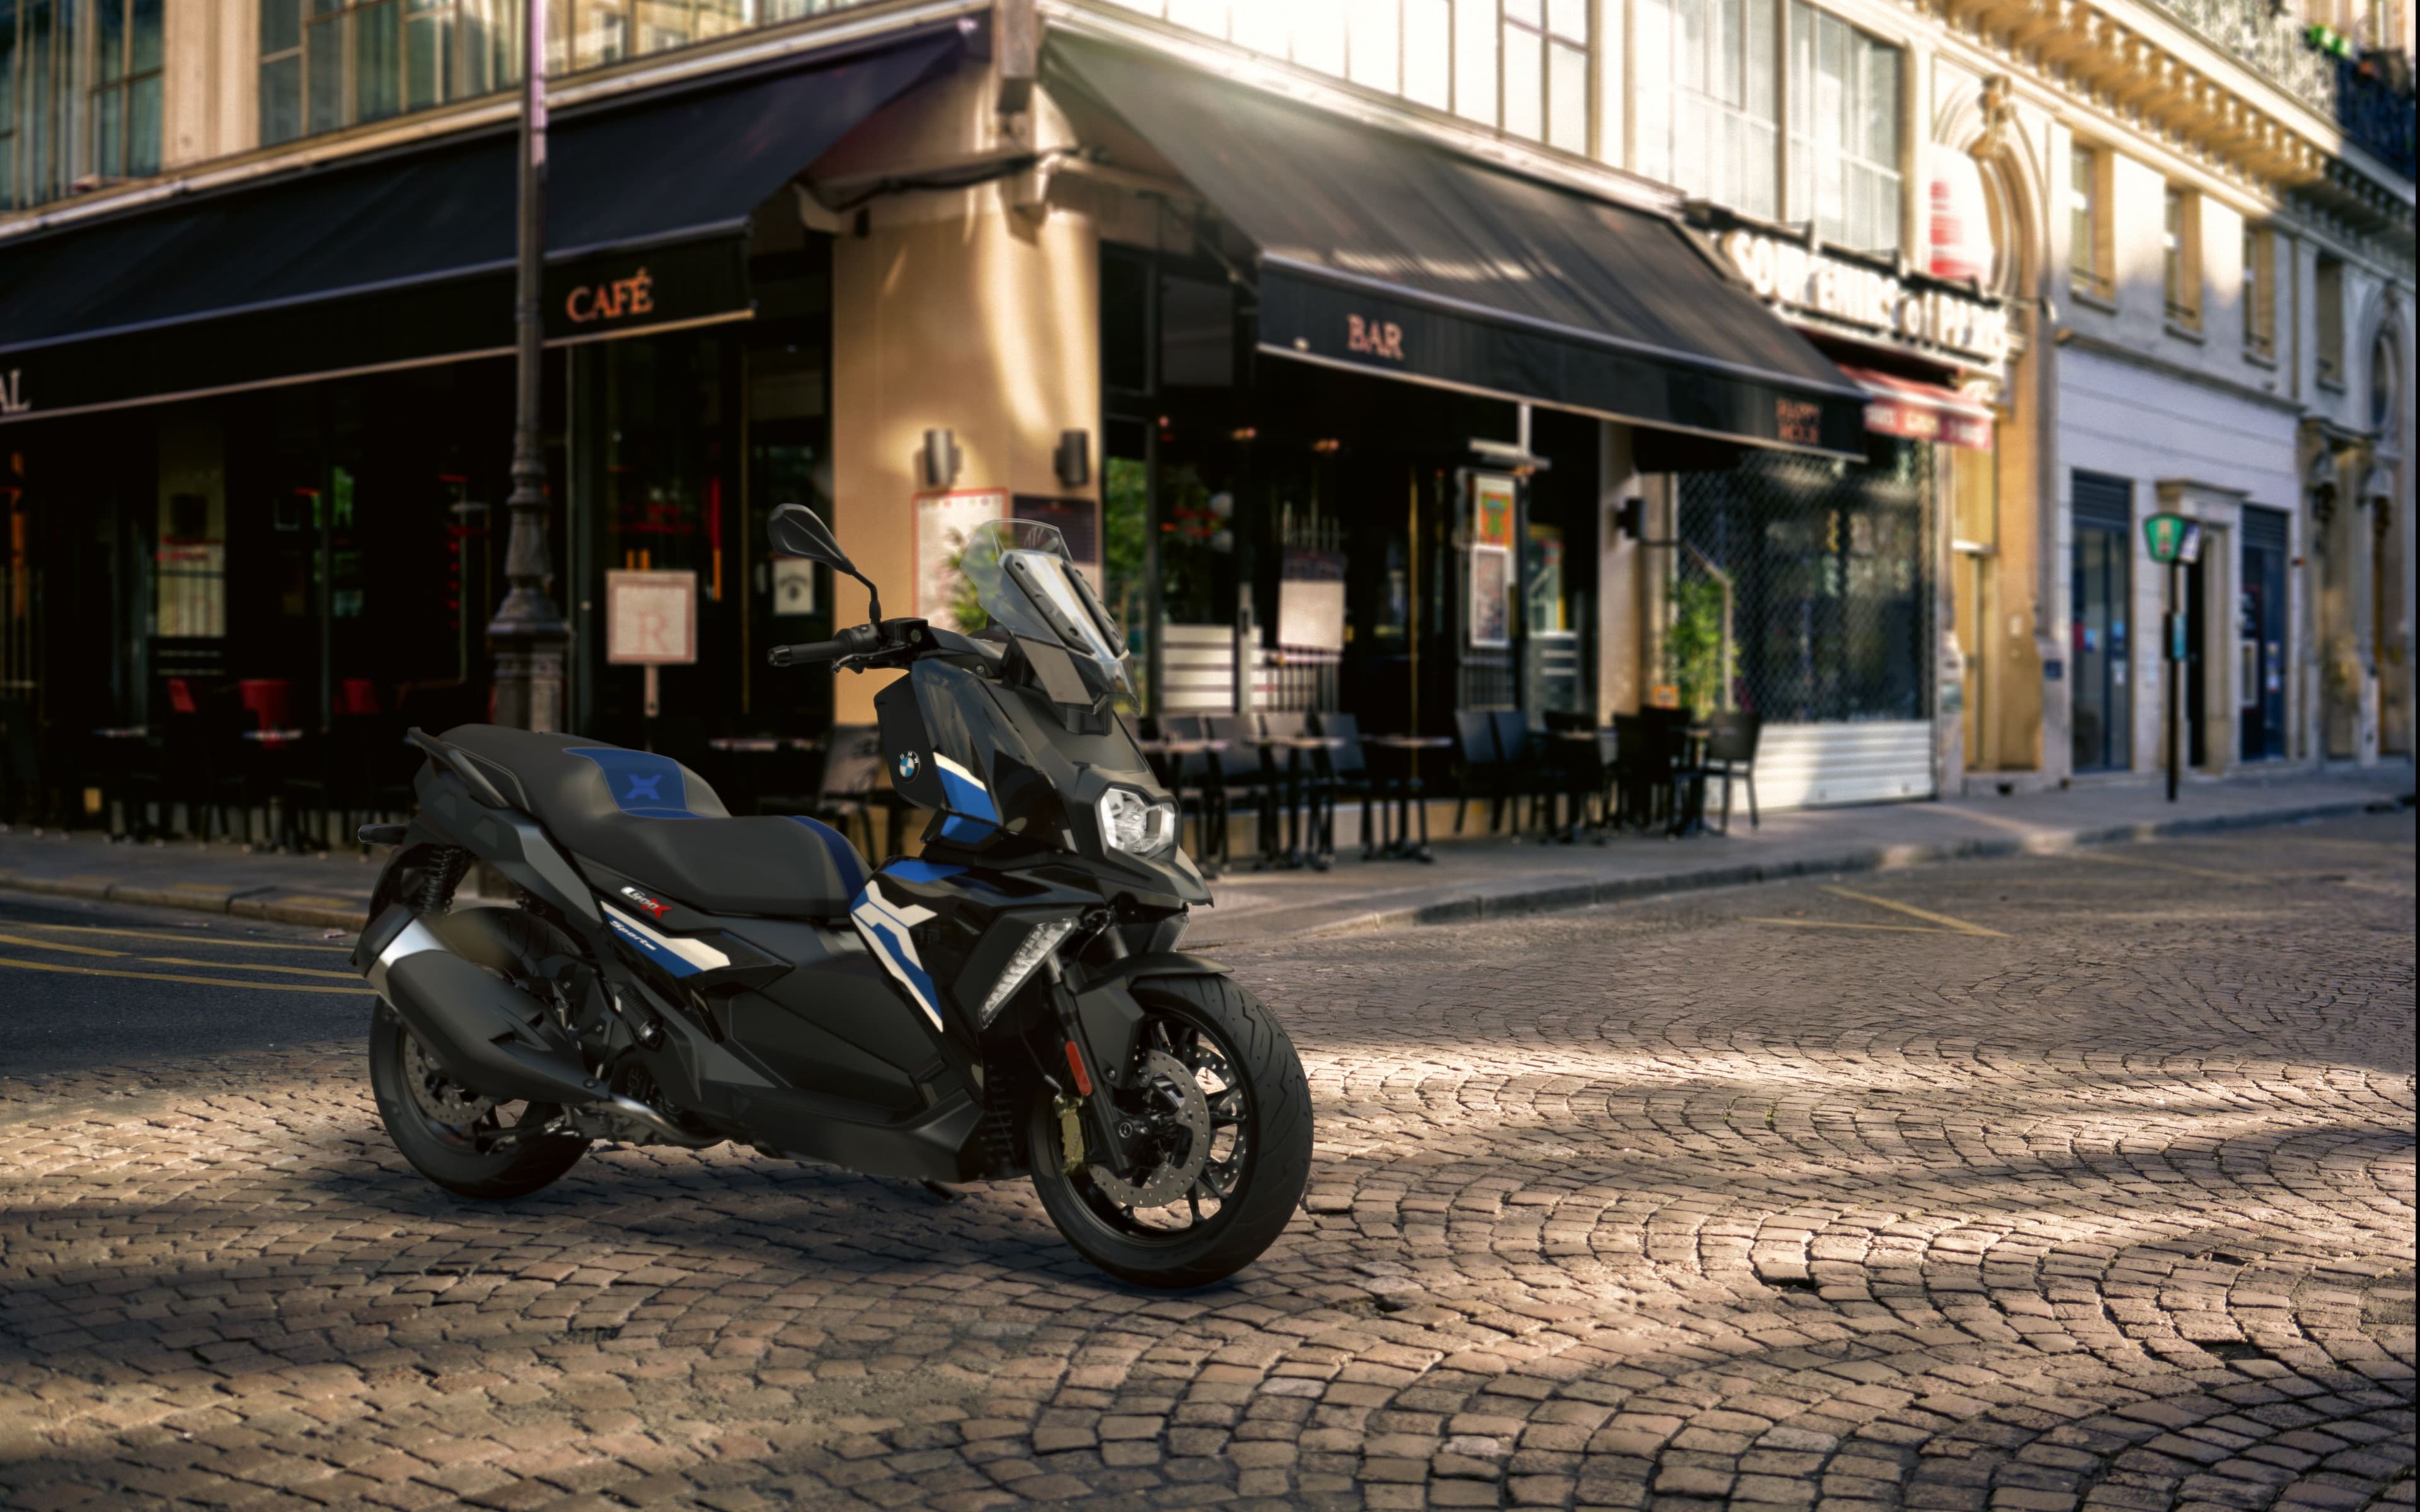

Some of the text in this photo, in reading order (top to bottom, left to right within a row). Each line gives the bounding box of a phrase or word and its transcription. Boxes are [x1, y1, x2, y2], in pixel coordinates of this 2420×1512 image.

[566, 265, 654, 323] CAFÉ
[1347, 313, 1405, 361] BAR
[899, 750, 919, 764] BMW
[609, 920, 653, 949] Sport
